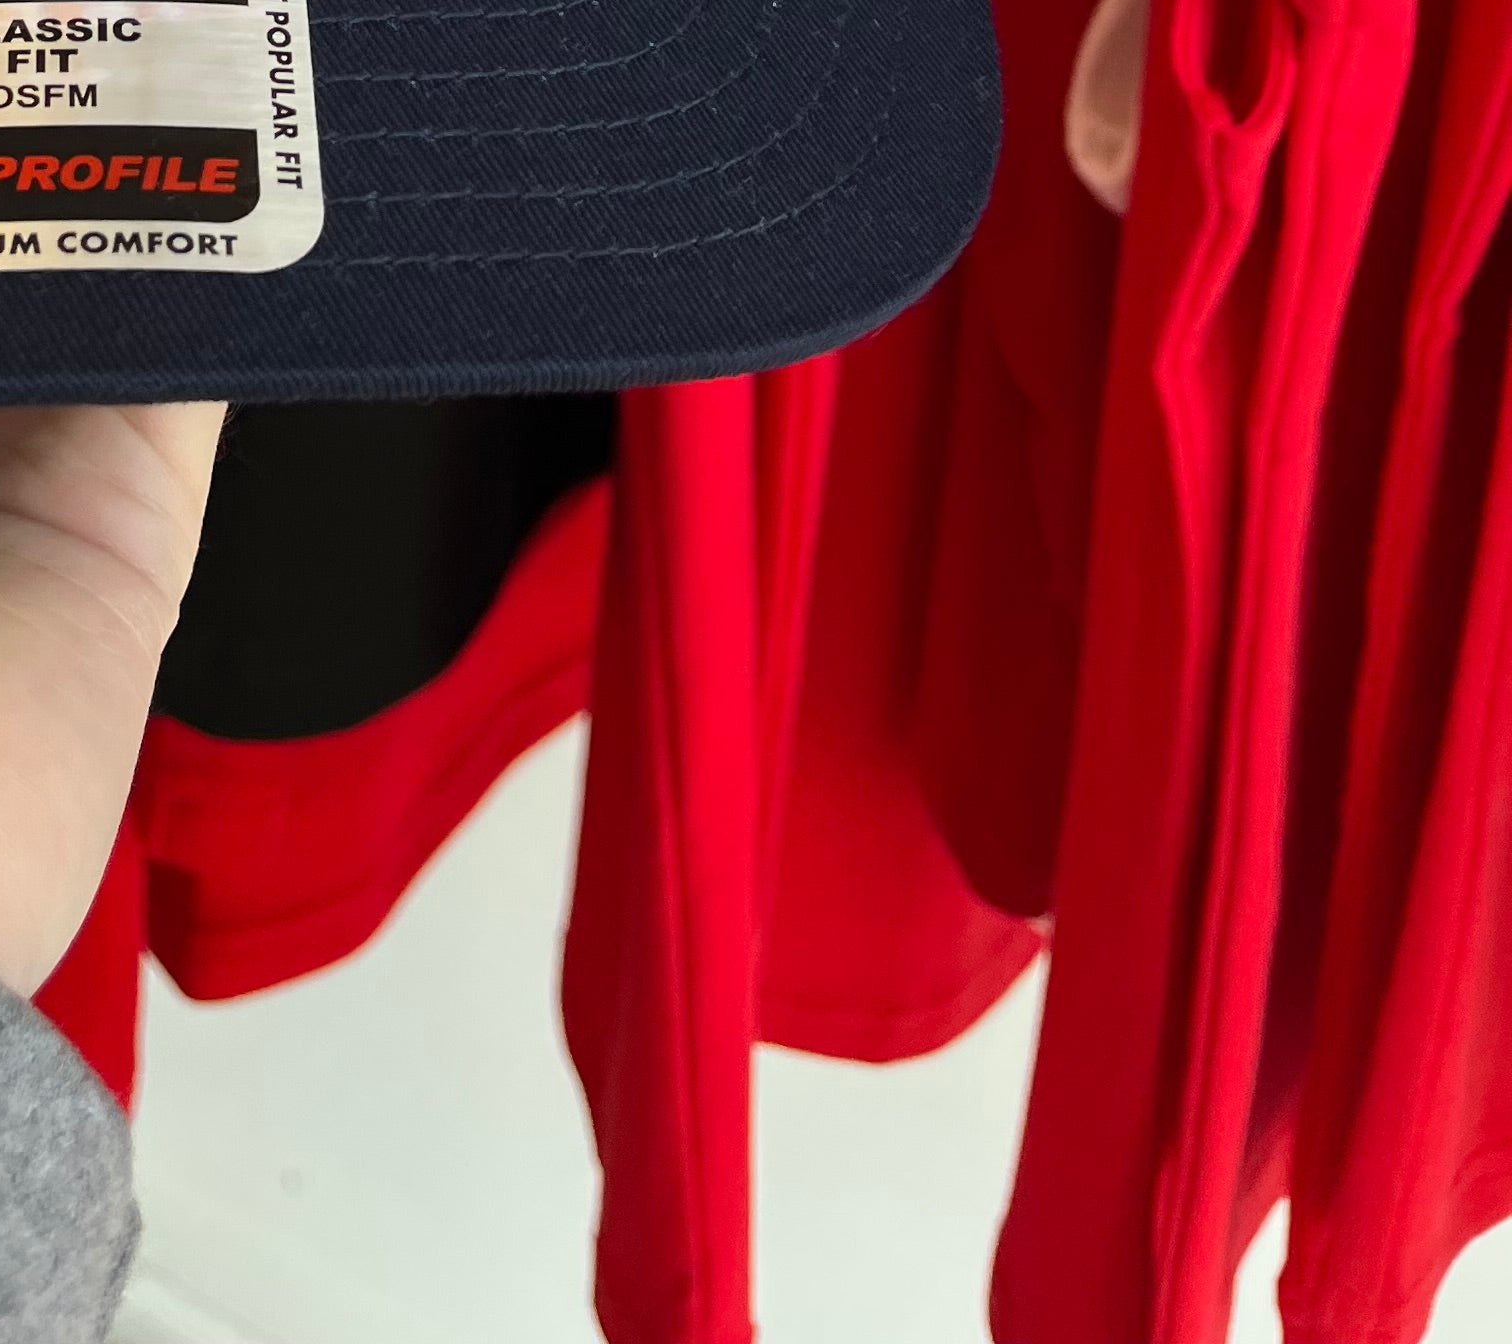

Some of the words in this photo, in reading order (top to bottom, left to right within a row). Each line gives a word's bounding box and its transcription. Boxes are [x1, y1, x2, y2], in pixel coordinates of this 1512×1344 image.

[7, 48, 79, 74] FIT
[265, 11, 300, 139] POPULAR
[275, 151, 304, 190] FIT
[57, 231, 238, 256] COMFORT
